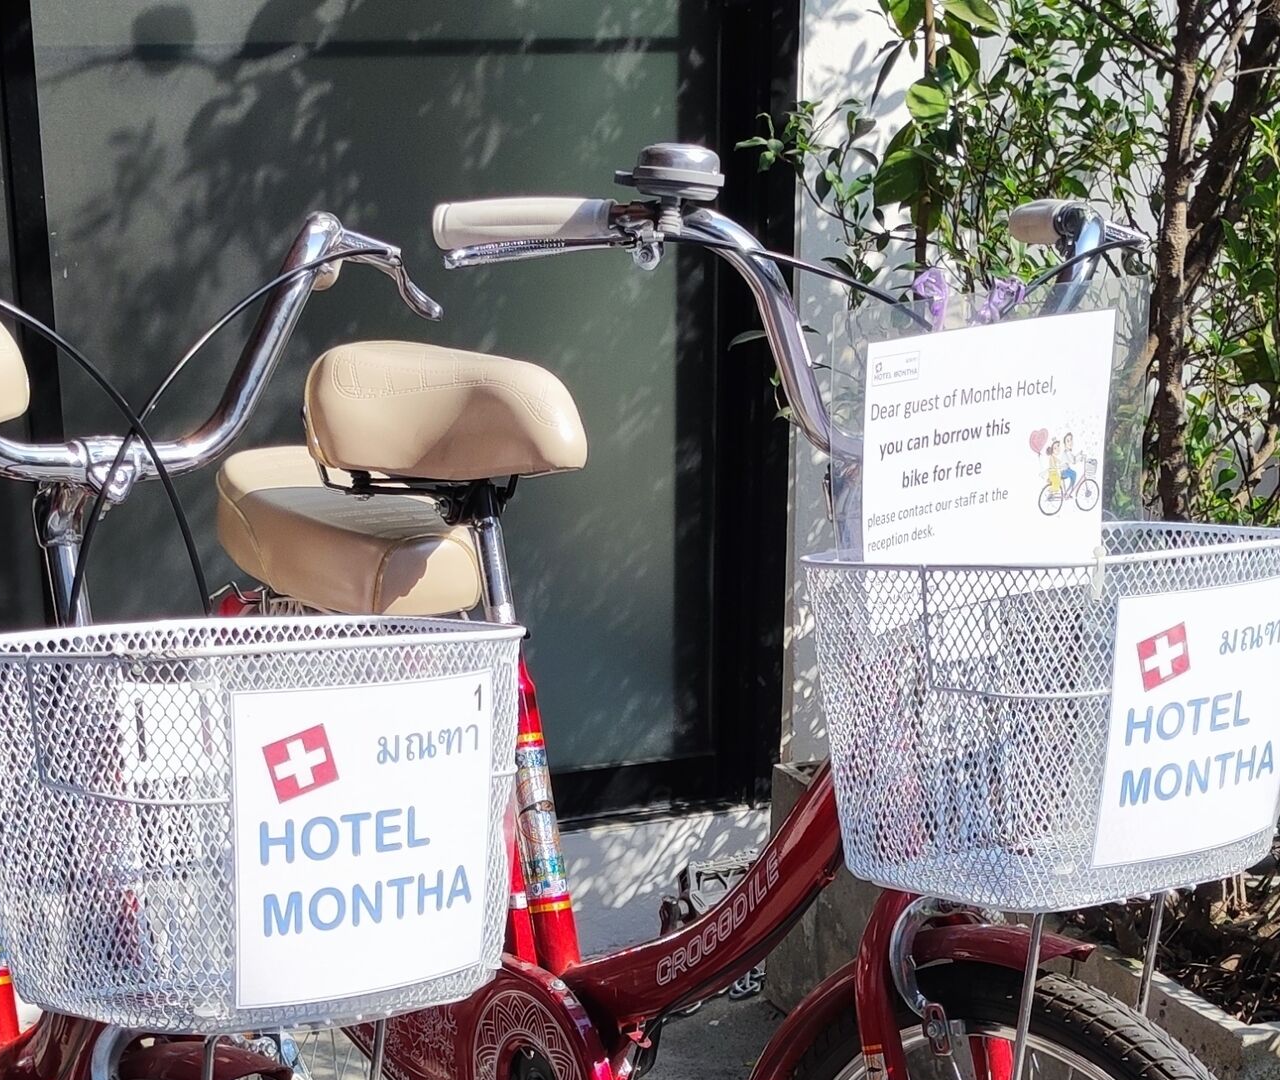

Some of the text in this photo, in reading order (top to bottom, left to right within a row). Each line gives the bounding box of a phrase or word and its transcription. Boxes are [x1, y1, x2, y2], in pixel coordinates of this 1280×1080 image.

[870, 375, 1057, 422] Dear guest of Montha Hotel,
[879, 418, 1011, 461] you can borrow this
[901, 461, 982, 489] bike for free
[867, 487, 1009, 529] please contact our staff at the
[867, 525, 936, 553] reception desk.
[473, 683, 483, 712] 1
[1126, 691, 1250, 746] HOTEL
[376, 724, 479, 765] มณฑา
[1118, 740, 1274, 807] MONTHA
[259, 805, 431, 866] HOTEL
[262, 864, 472, 938] MONTHA
[655, 848, 780, 987] CROCODILE
